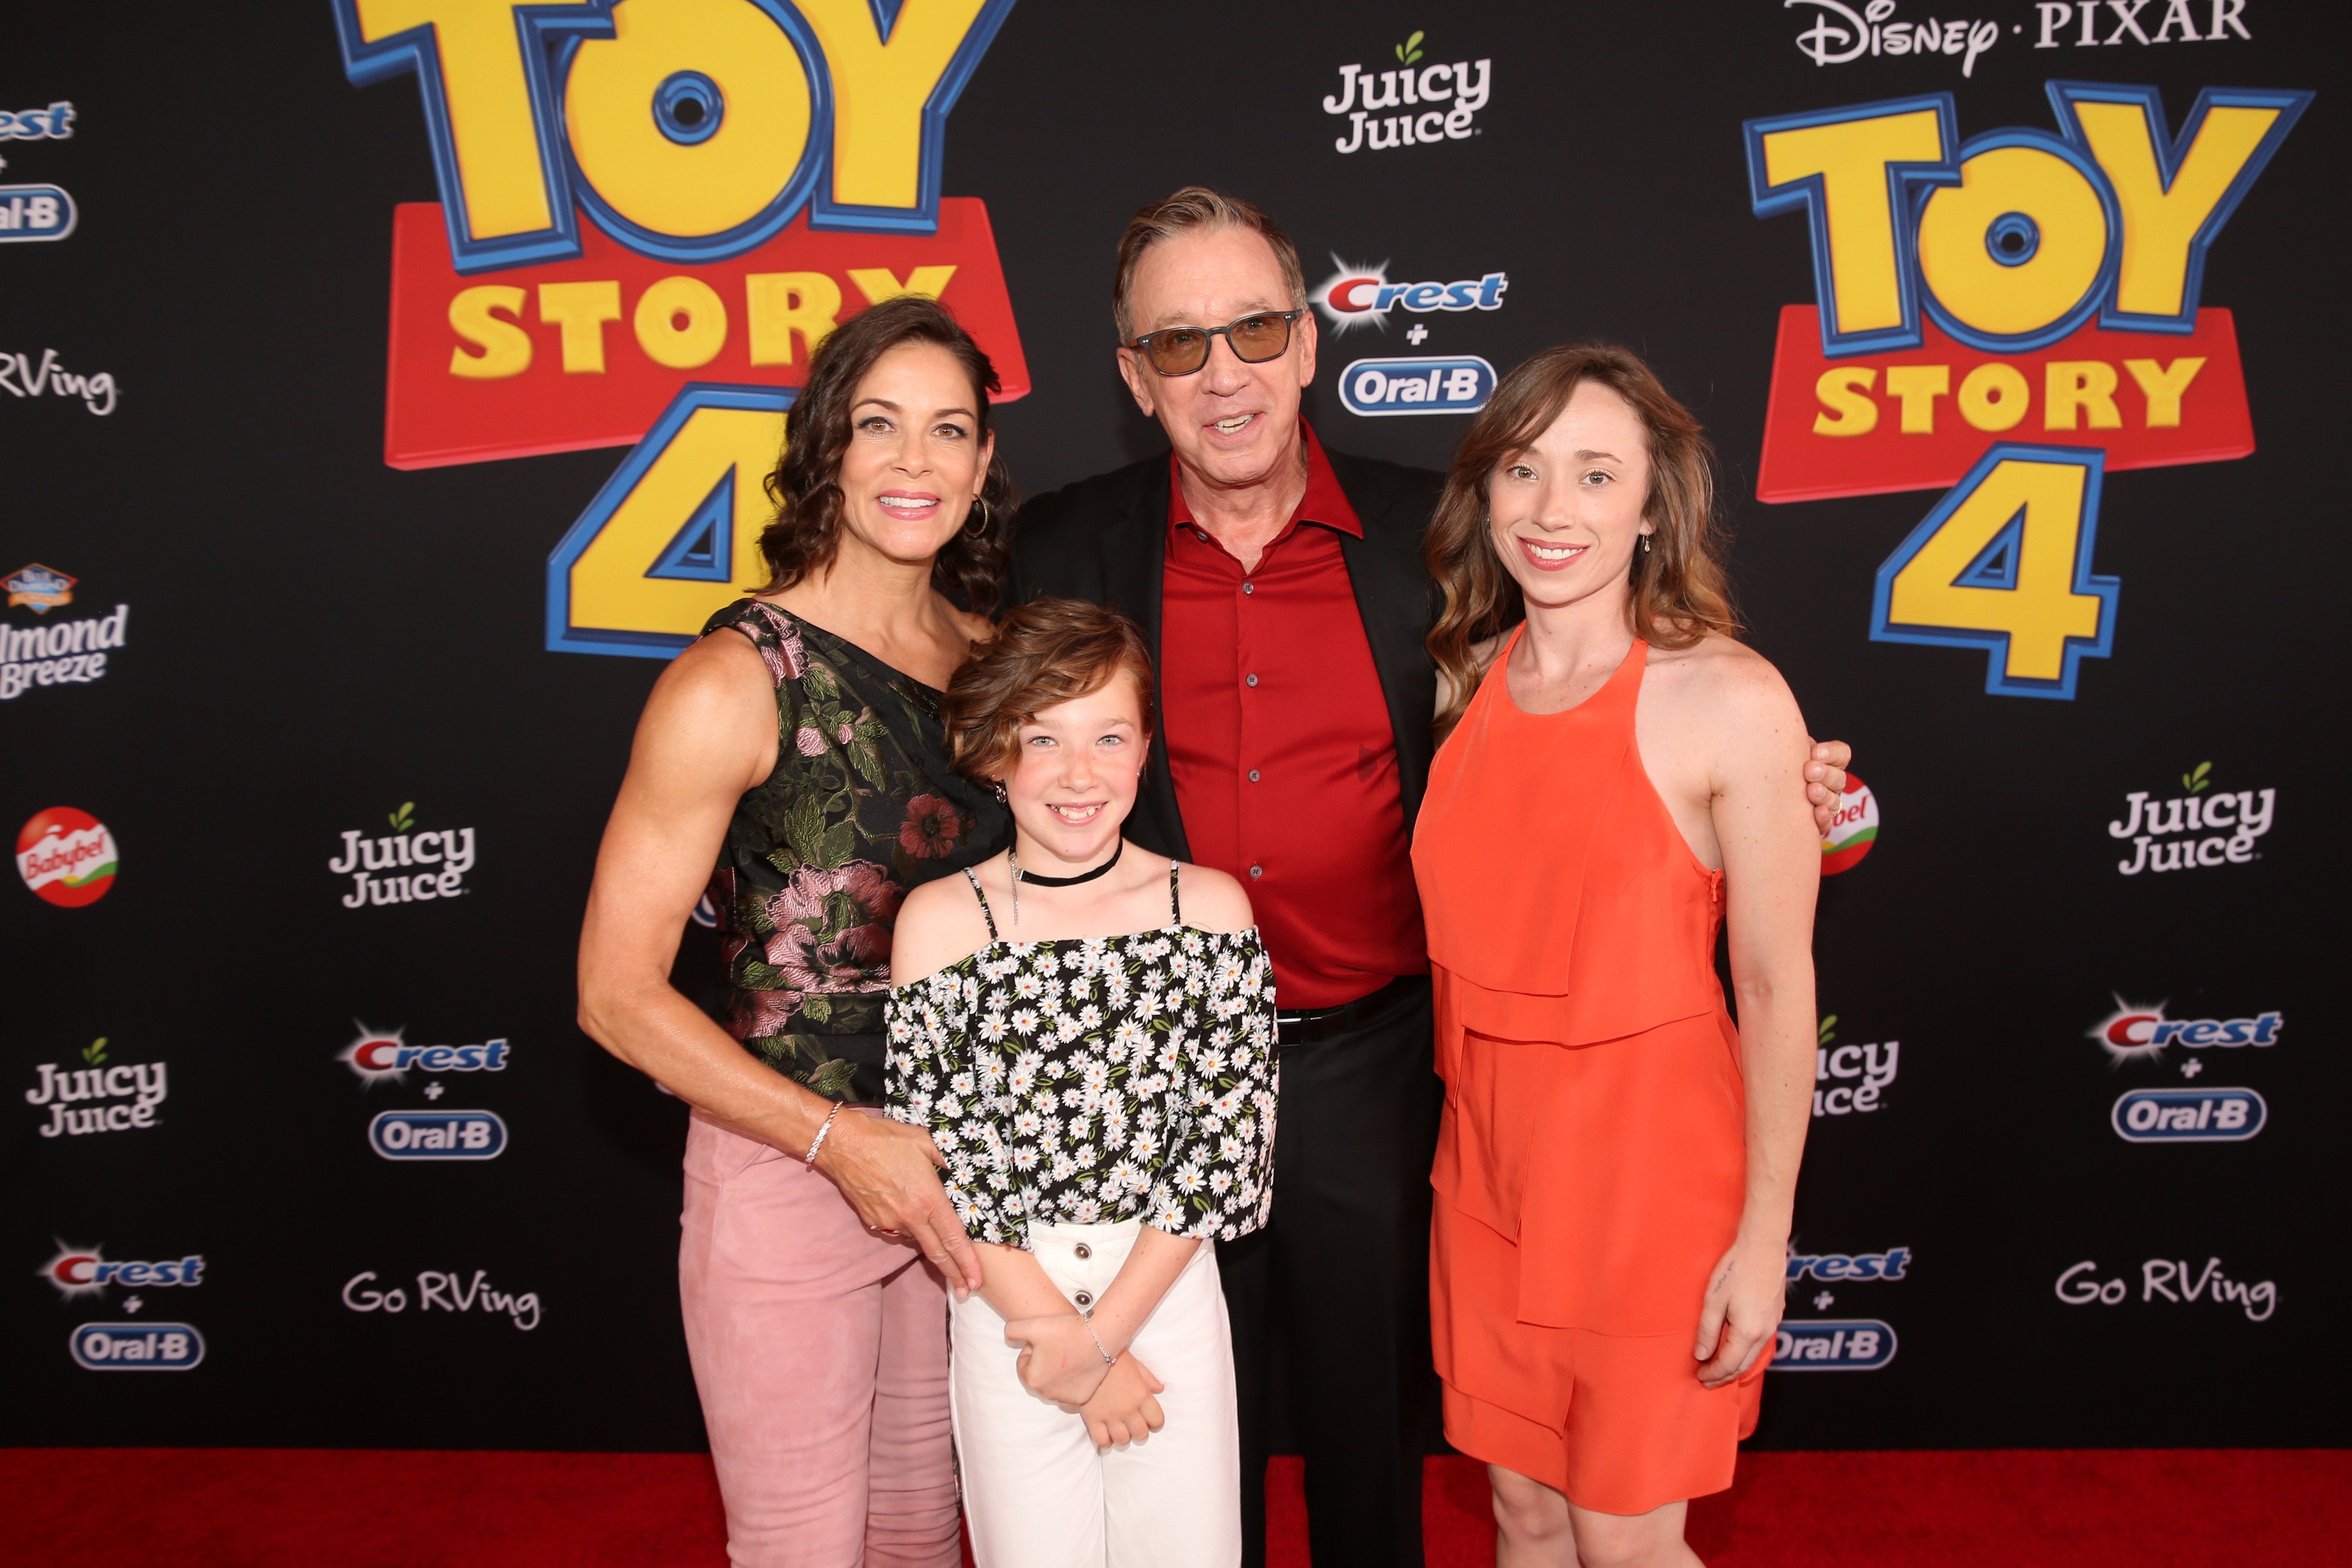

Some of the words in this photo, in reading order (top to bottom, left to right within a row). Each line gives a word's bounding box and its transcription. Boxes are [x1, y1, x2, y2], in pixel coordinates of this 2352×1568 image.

[2034, 0, 2252, 49] PIXAR
[1323, 58, 1491, 114] Juicy
[330, 0, 1019, 275] TOY
[1335, 111, 1473, 154] Juice
[1743, 79, 2316, 359] TOY
[1326, 273, 1508, 313] Crest
[1354, 369, 1479, 406] Oral-B
[1812, 356, 2207, 437] STORY
[545, 380, 802, 659] 4
[1869, 441, 2121, 701] 4
[0, 604, 129, 665] lmond
[0, 652, 107, 700] Breeze
[2108, 788, 2276, 839] Juicy
[26, 830, 106, 880] Babybel
[329, 827, 476, 874] Juicy
[2118, 836, 2255, 876] Juice
[342, 871, 463, 909] Juice
[2105, 1011, 2282, 1047] Crest
[354, 1038, 509, 1070] Crest
[1816, 1040, 1900, 1088] icy
[25, 1061, 167, 1105] Juicy
[1812, 1086, 1880, 1118] ice
[39, 1102, 156, 1138] Juice
[382, 1120, 492, 1151] Oral-B
[2125, 1099, 2248, 1130] Oral-B
[54, 1255, 205, 1287] Crest
[1786, 1247, 1912, 1281] rest
[342, 1271, 407, 1313] Go
[418, 1269, 540, 1331] RVing
[2055, 1260, 2126, 1305] Go
[2142, 1257, 2276, 1321] RVing
[83, 1332, 189, 1360] Oral-B
